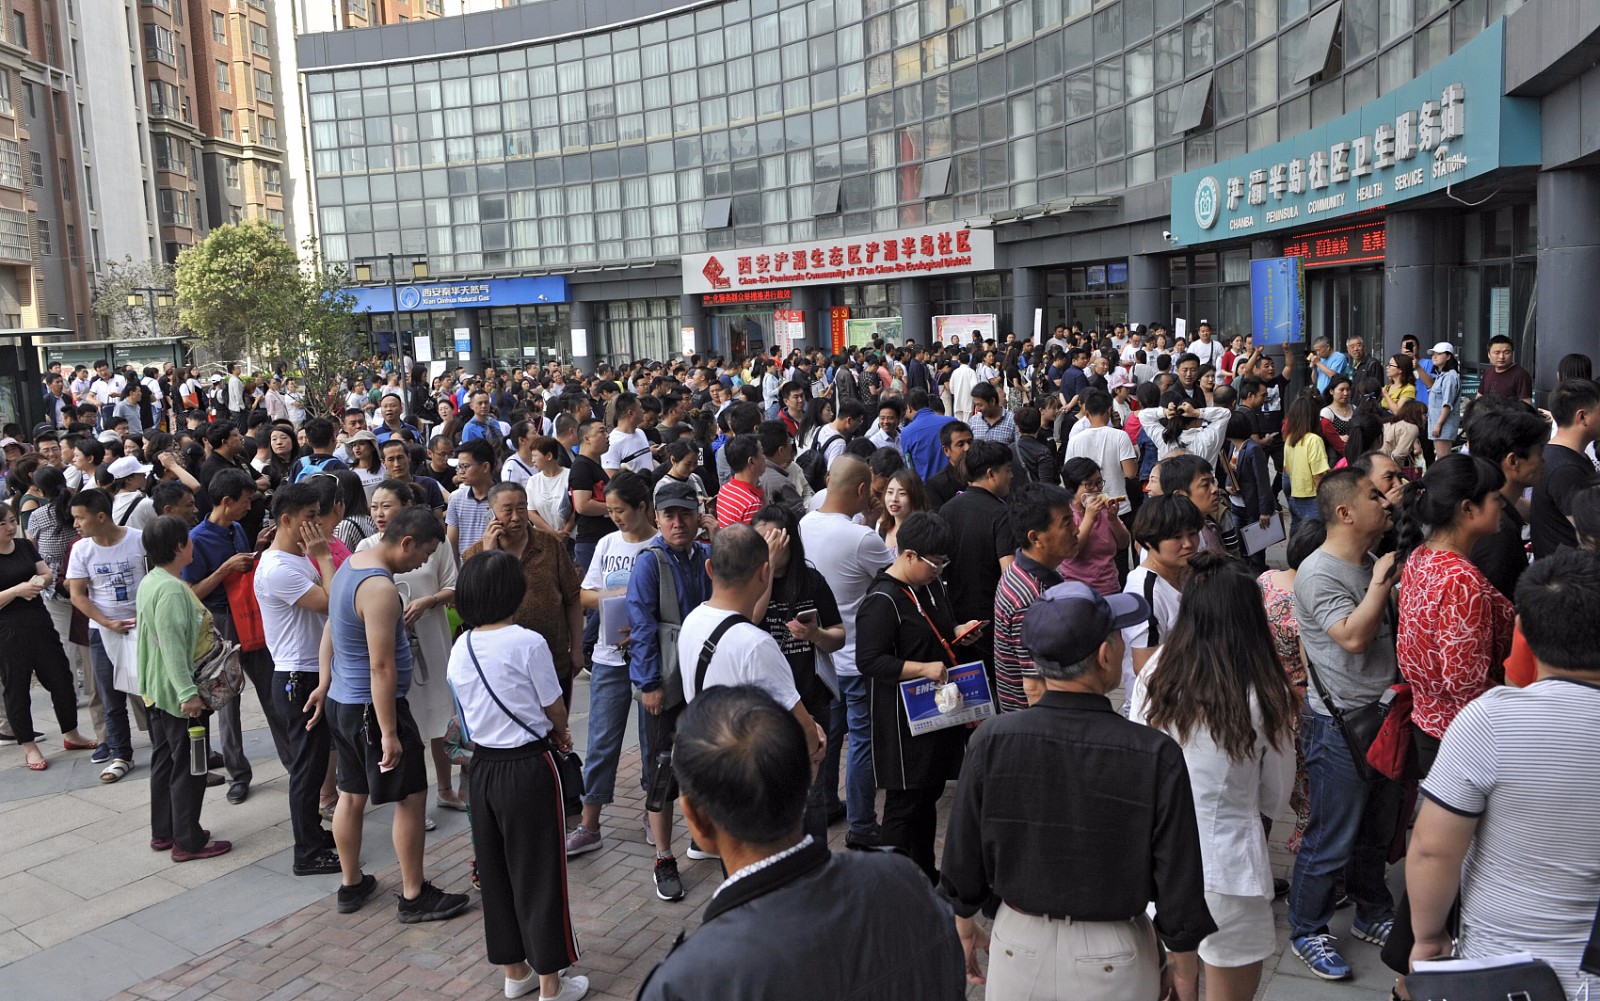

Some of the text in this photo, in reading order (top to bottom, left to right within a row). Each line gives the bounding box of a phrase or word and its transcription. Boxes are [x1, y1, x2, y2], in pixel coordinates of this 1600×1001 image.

[1226, 82, 1465, 211] 浐灞半岛社区卫生服务站
[1266, 205, 1299, 224] PENINSULA
[1307, 192, 1346, 215] COMMUNITY
[1356, 181, 1383, 202] HEALTH
[1394, 167, 1424, 192] SERVICE
[769, 273, 805, 283] Peninsula
[805, 269, 846, 280] Community
[846, 267, 855, 277] of
[905, 259, 944, 271] Ecological
[944, 255, 972, 267] District
[422, 284, 490, 297] 西安秦华天然气
[457, 295, 478, 303] Natural
[478, 294, 490, 302] Gas
[915, 681, 937, 696] EMS
